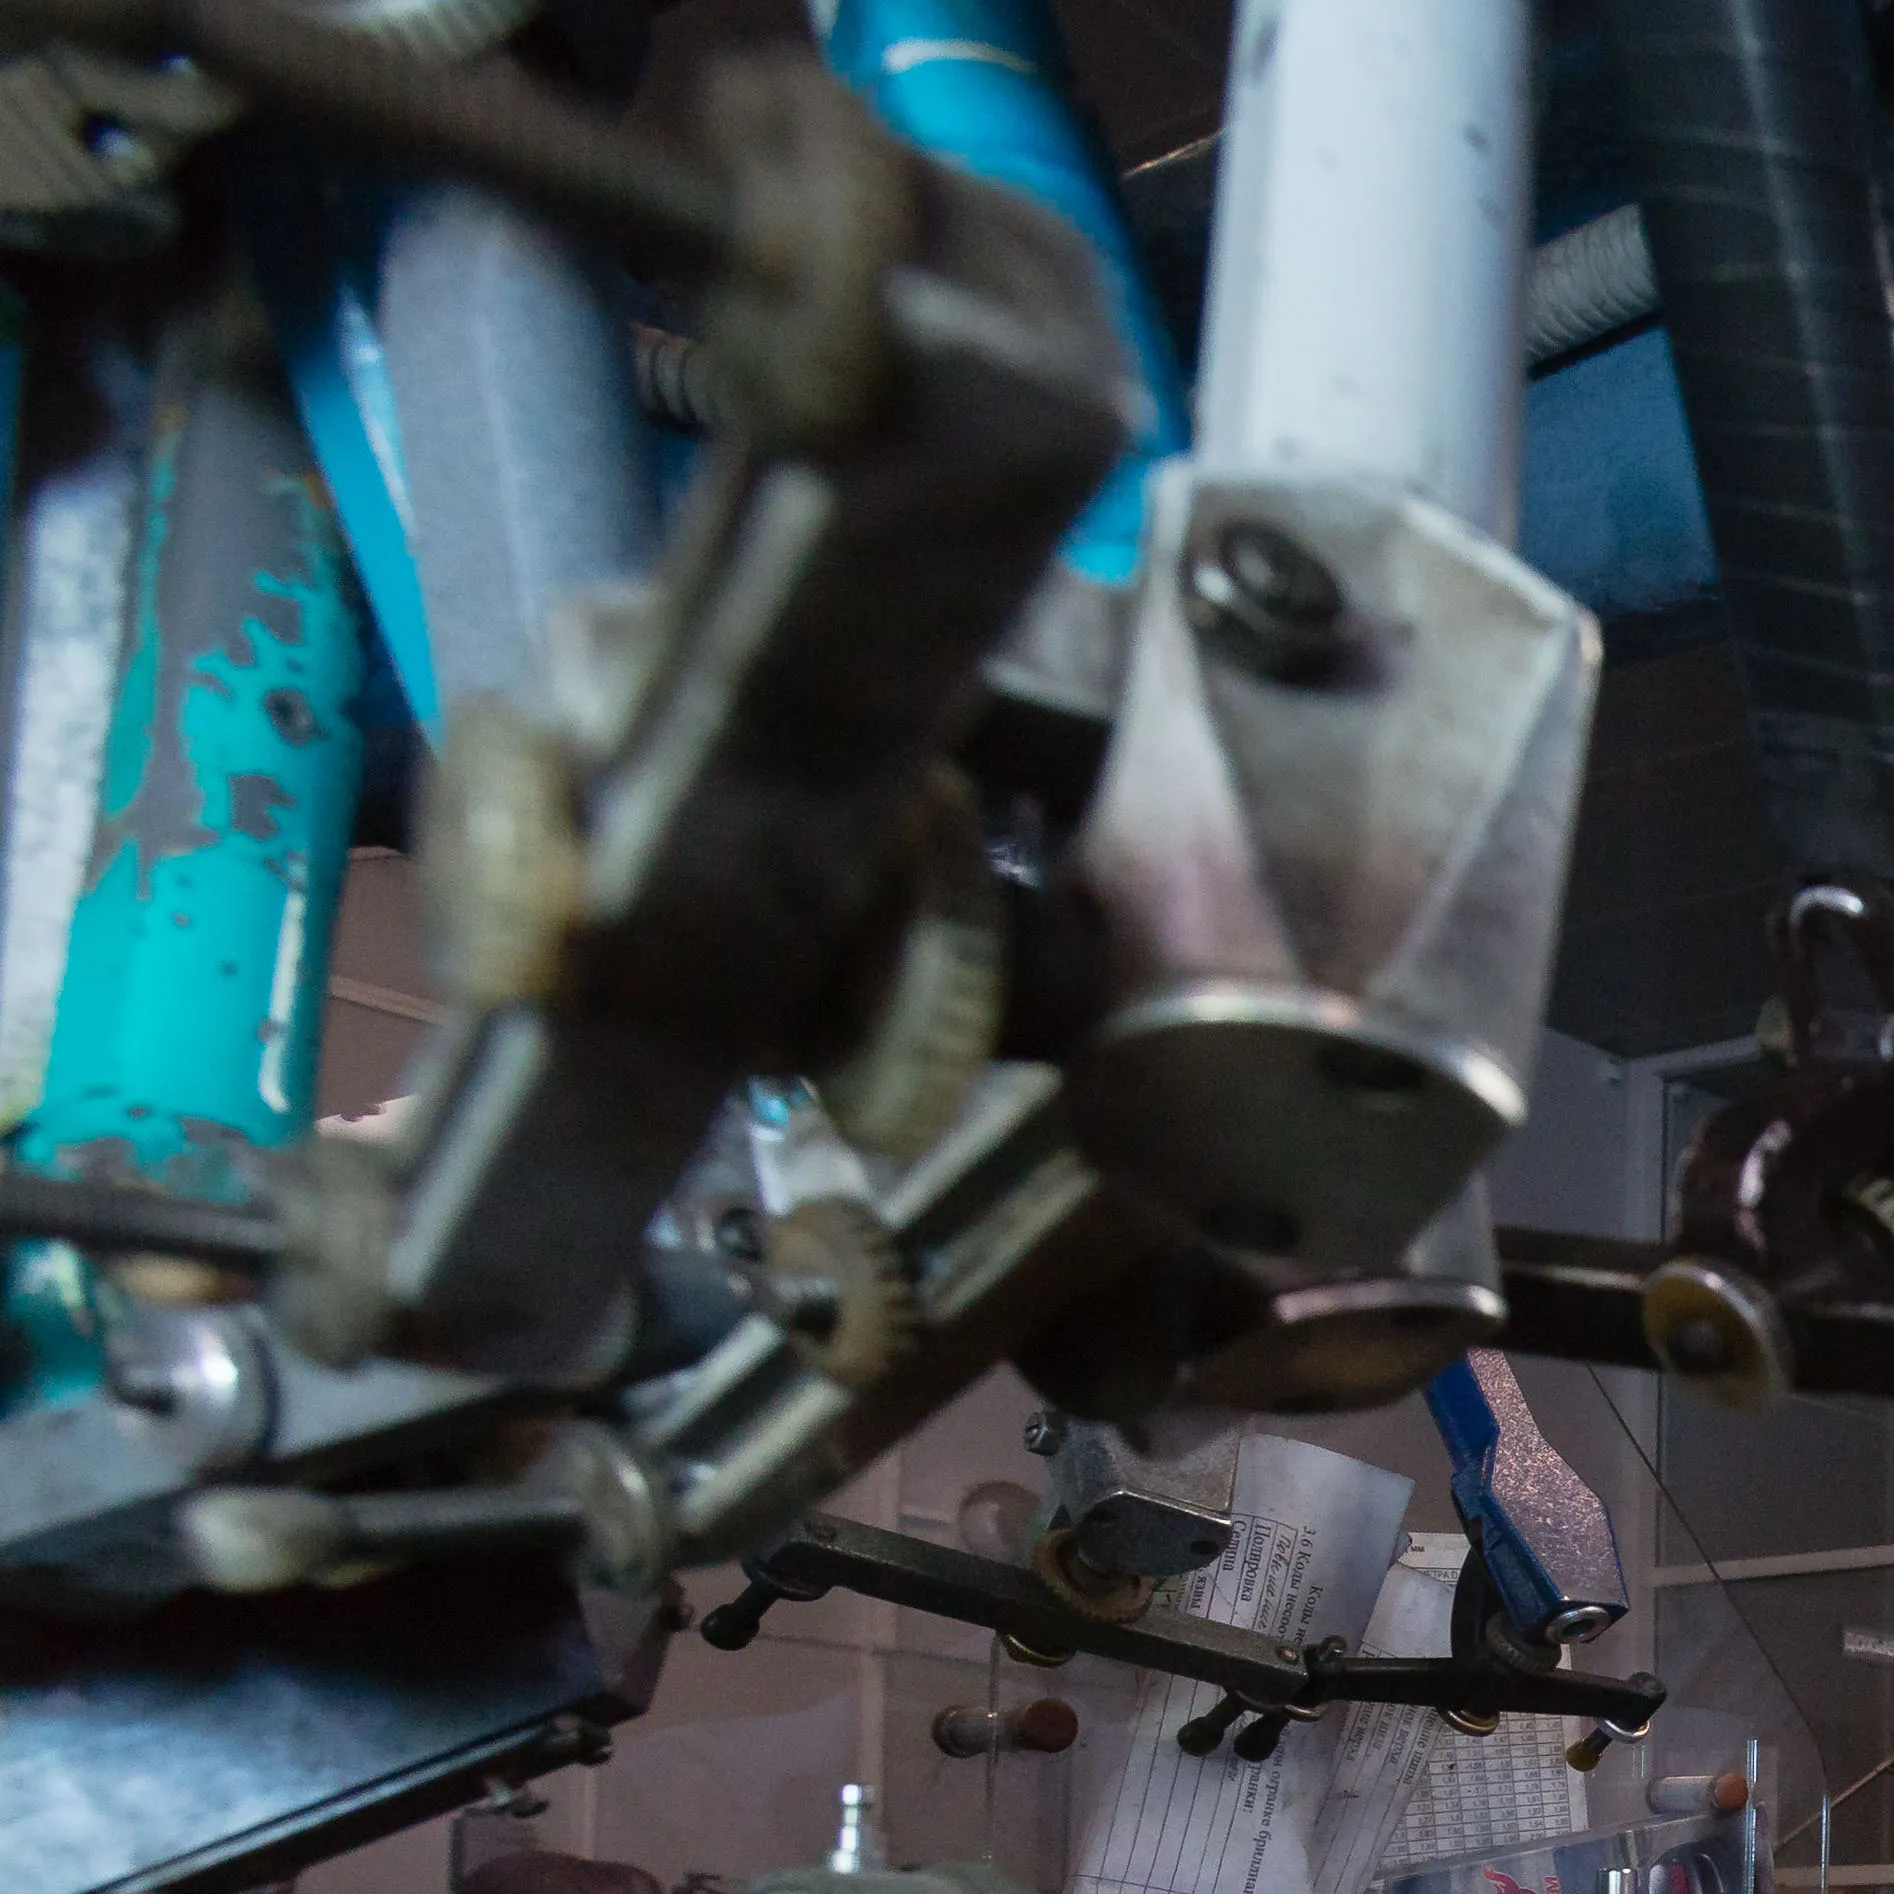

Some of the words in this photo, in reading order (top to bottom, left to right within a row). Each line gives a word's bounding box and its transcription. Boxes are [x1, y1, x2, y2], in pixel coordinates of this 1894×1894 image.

[1301, 1525, 1316, 1548] 3.6
[1240, 1524, 1271, 1602] Полировка
[1291, 1551, 1311, 1589] Коды
[1300, 1585, 1323, 1624] Коды
[1260, 1771, 1281, 1827] огранке
